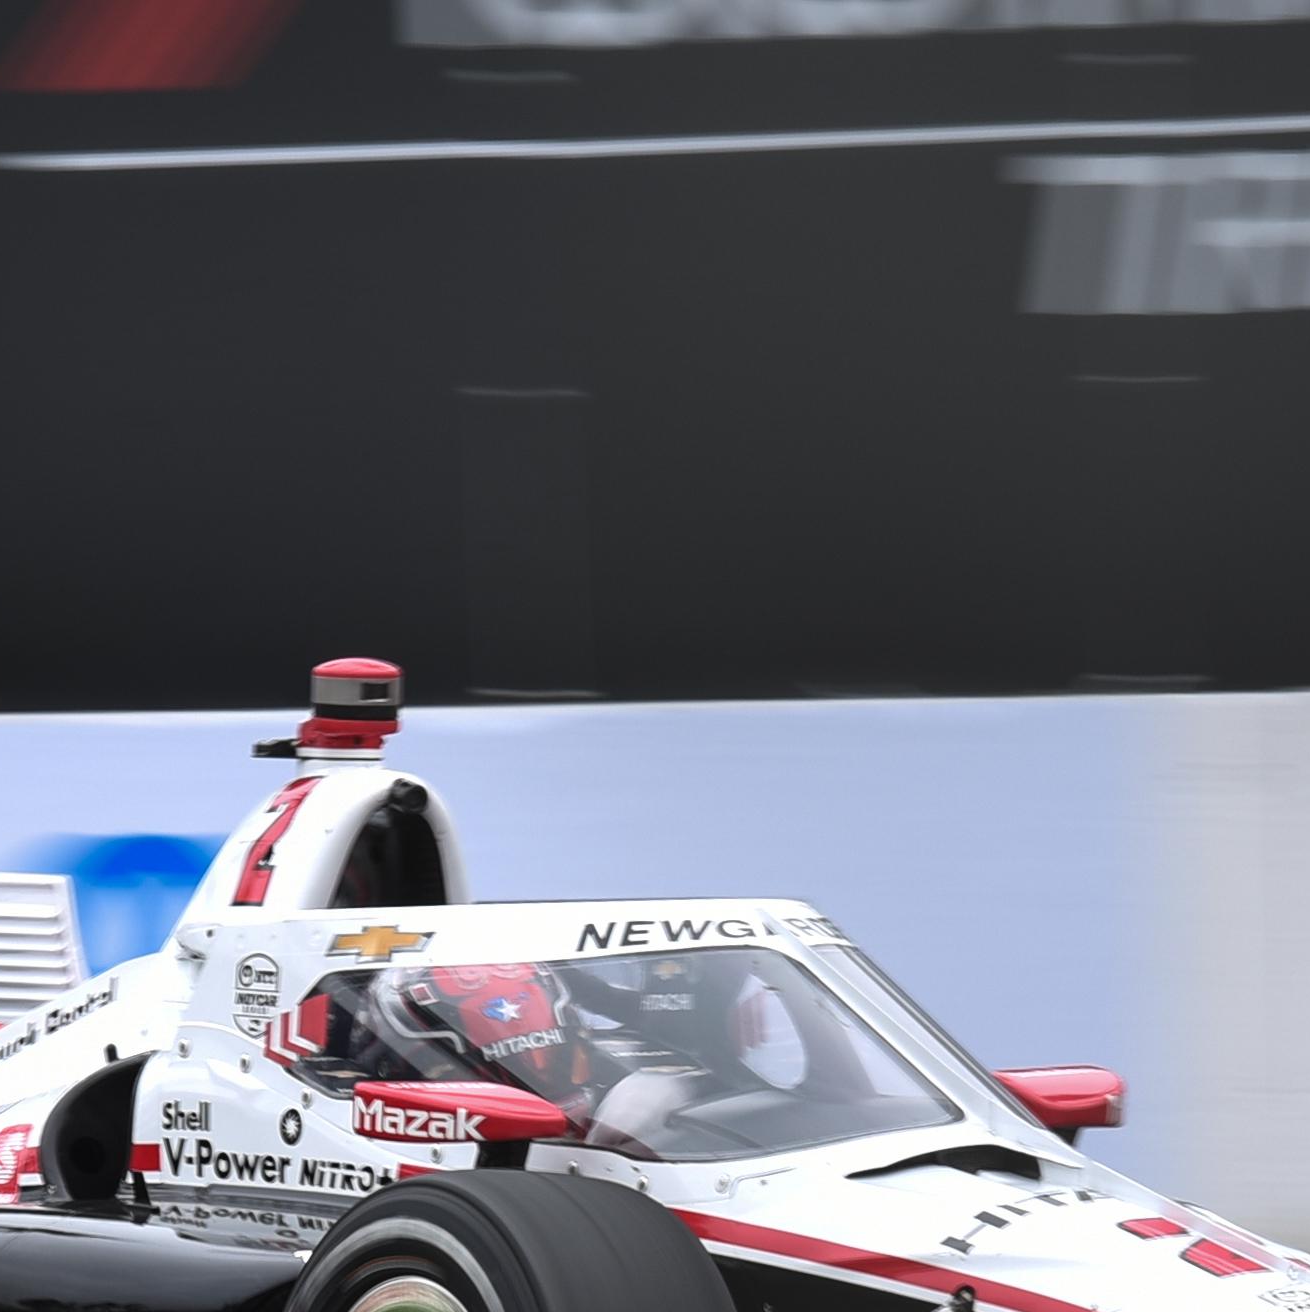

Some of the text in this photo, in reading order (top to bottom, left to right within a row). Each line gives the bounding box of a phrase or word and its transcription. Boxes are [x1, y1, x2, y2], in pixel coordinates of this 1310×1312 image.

[481, 1028, 564, 1062] HITACHI
[162, 1100, 211, 1133] Shell
[353, 1096, 487, 1141] Mazak
[162, 1138, 291, 1184] V-Power
